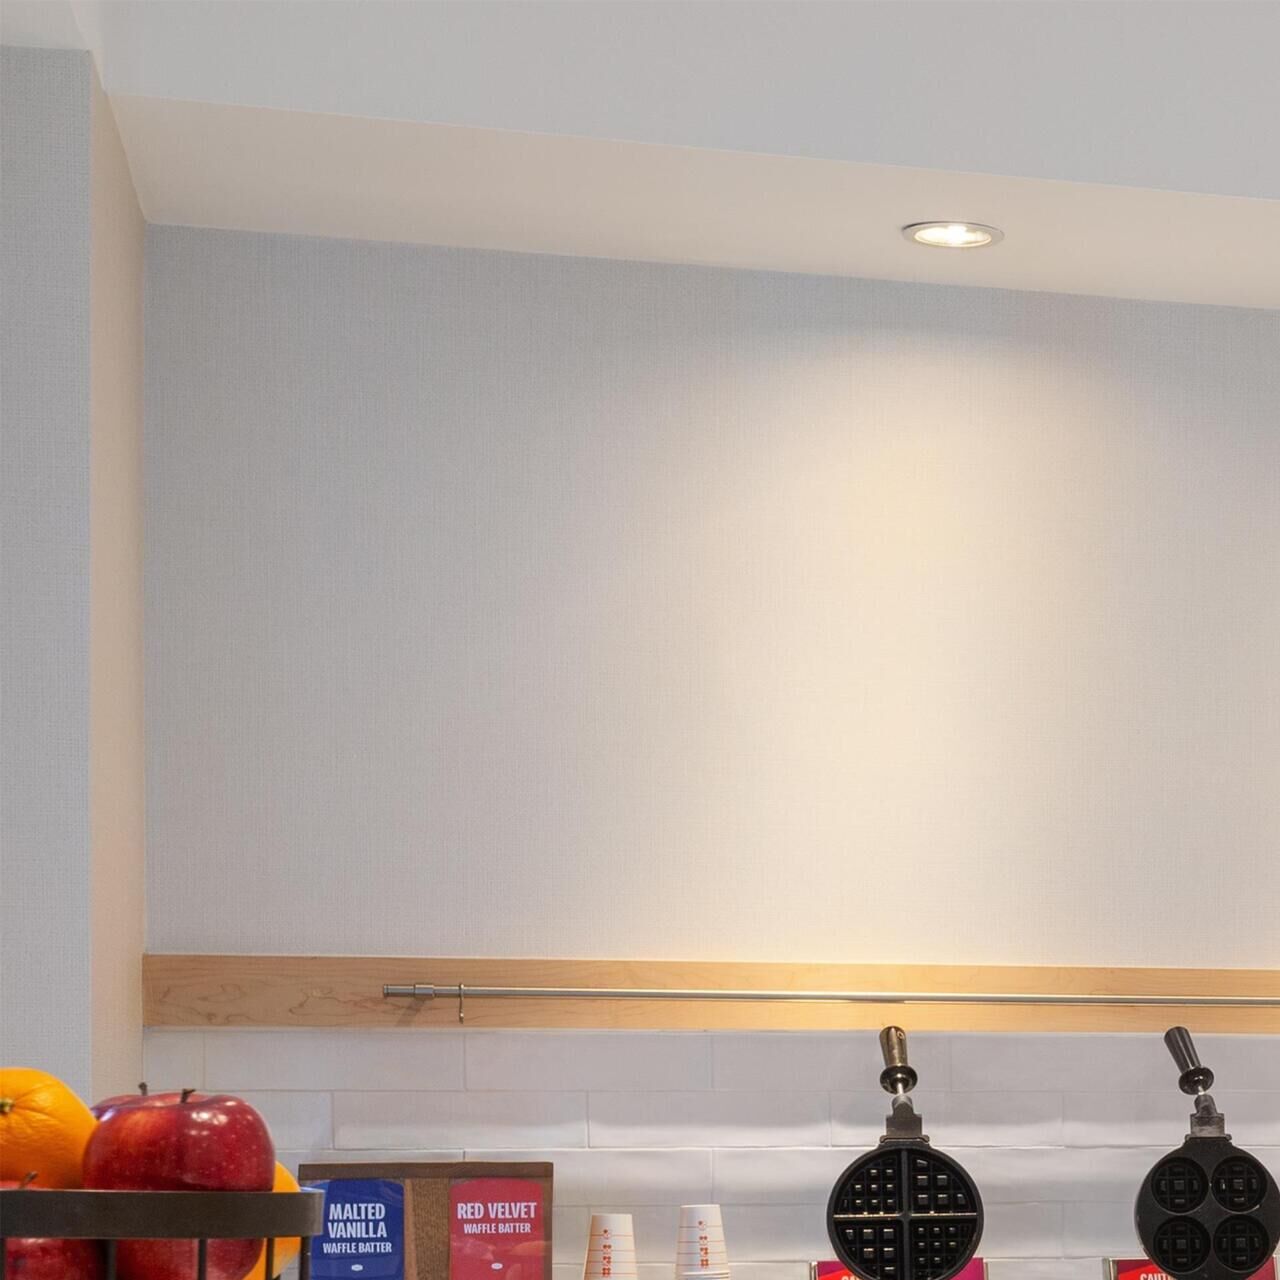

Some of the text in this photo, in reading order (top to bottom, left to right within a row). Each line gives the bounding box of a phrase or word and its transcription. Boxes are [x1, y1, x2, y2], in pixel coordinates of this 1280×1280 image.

[329, 1203, 385, 1220] MALTED
[457, 1201, 537, 1219] RED VELVET
[327, 1222, 387, 1238] VANILLA
[463, 1222, 531, 1234] WAFFLE BATTER
[322, 1242, 392, 1254] WAFFLE BATTER
